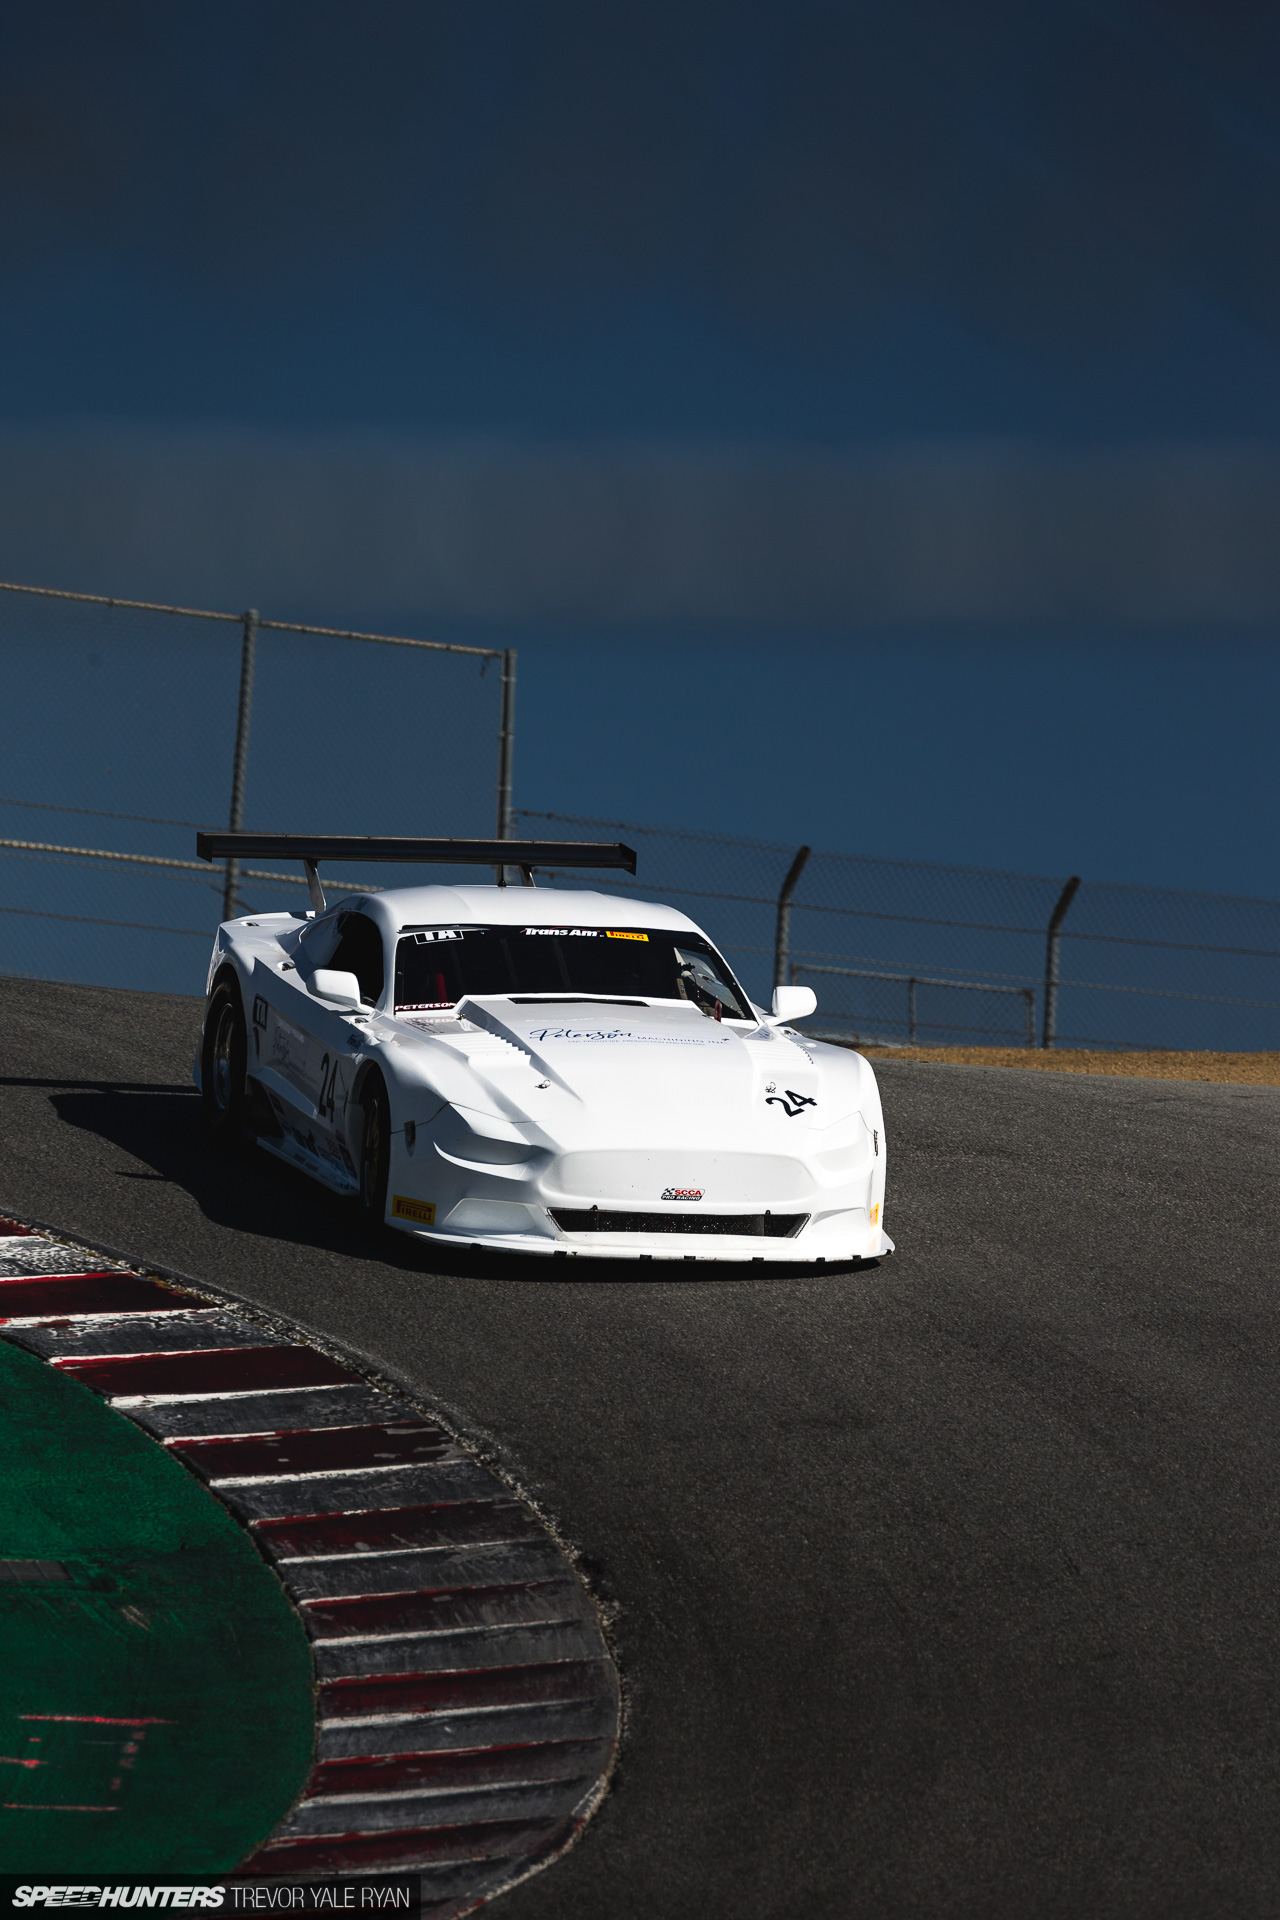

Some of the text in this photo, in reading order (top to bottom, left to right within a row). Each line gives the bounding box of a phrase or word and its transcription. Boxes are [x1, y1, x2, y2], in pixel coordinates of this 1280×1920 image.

[423, 930, 457, 941] TA
[525, 927, 598, 937] Trans Am
[529, 1027, 634, 1042] Peterson
[318, 1053, 339, 1123] 24
[765, 1090, 818, 1117] 24
[396, 1200, 433, 1222] PIRELLI
